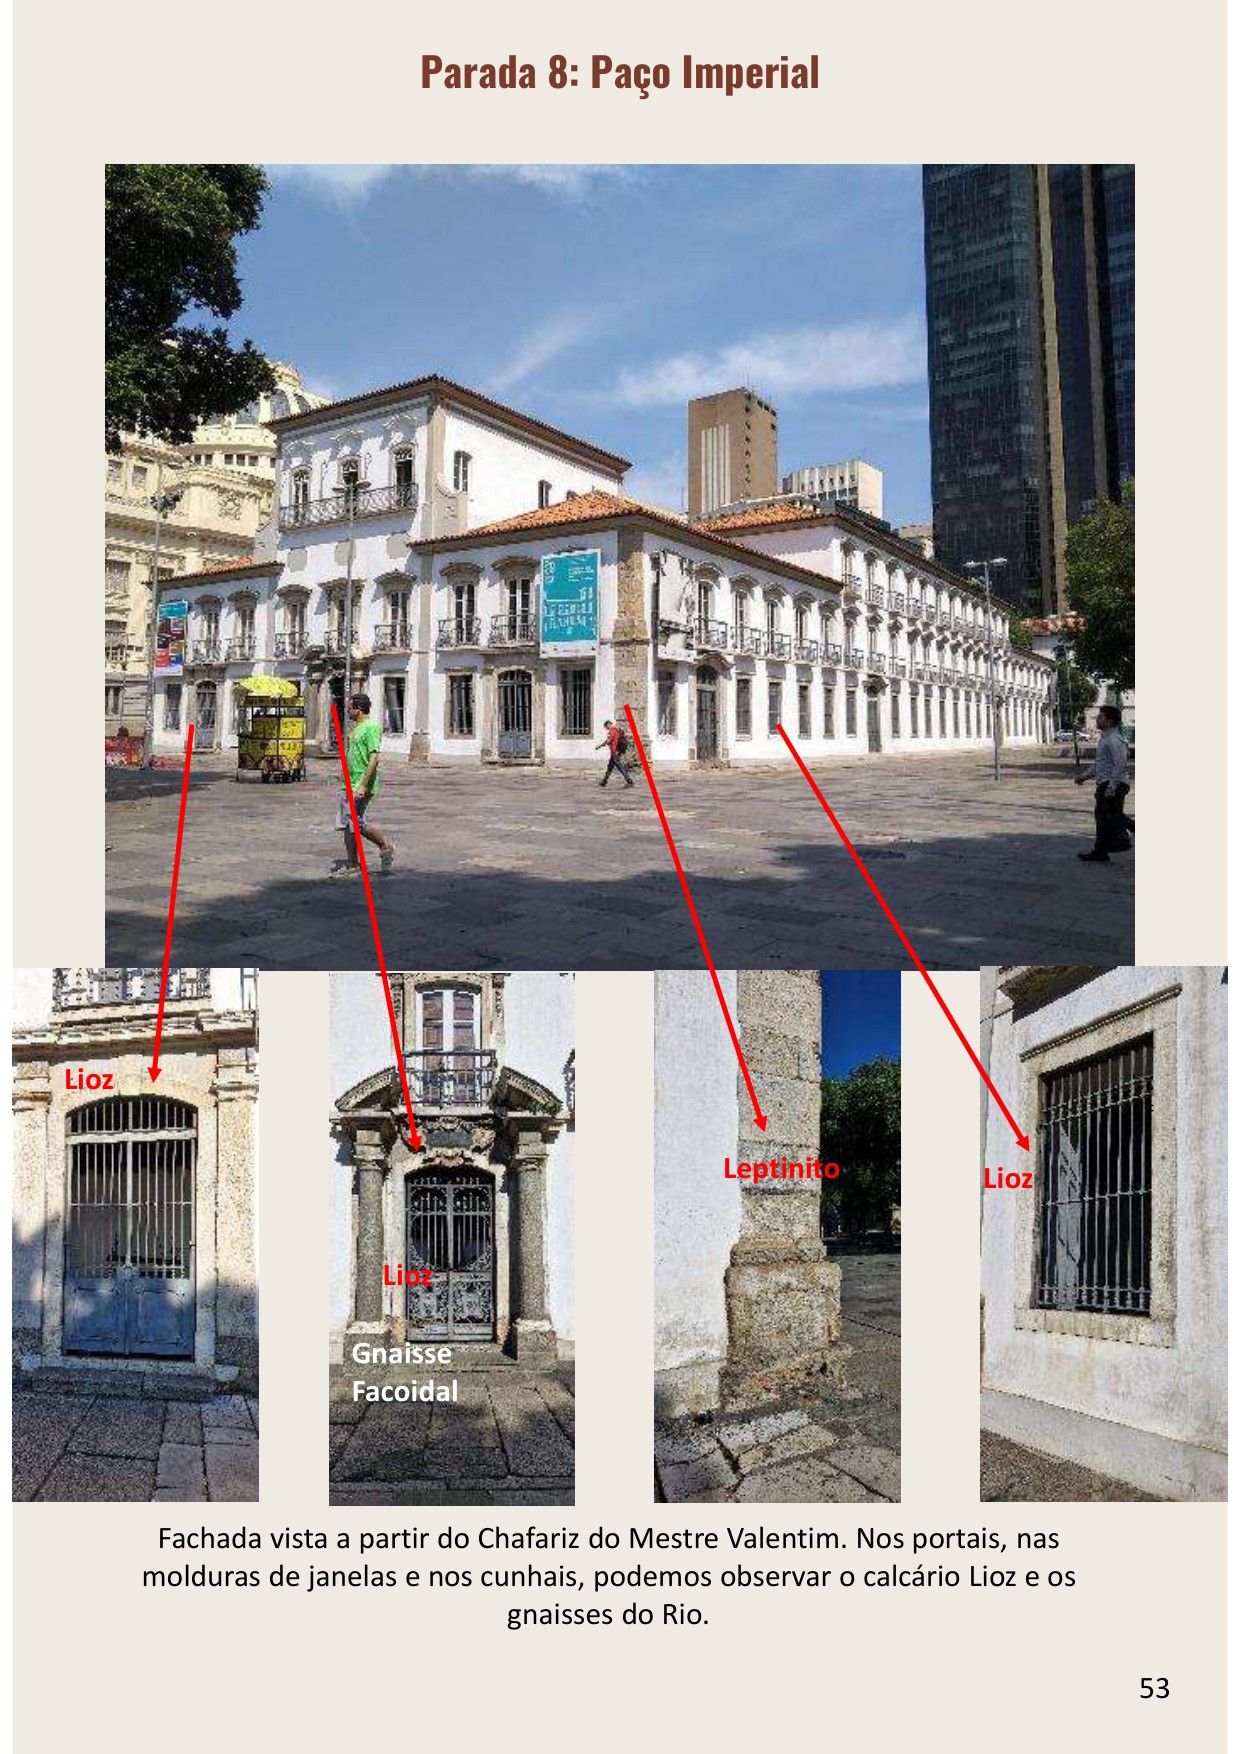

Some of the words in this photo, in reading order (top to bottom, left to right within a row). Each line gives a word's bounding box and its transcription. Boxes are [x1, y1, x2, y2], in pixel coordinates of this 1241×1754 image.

[421, 54, 536, 90] Parada
[548, 54, 579, 90] 8:
[591, 54, 671, 100] Paço
[683, 54, 819, 97] Imperial
[159, 1526, 262, 1550] Fachada
[269, 1526, 328, 1550] vista
[336, 1532, 350, 1550] a
[360, 1526, 430, 1555] partir
[437, 1525, 470, 1550] do
[478, 1525, 580, 1550] Chafariz
[588, 1525, 621, 1550] do
[629, 1527, 719, 1550] Mestre
[726, 1525, 847, 1550] Valentim.
[857, 1527, 905, 1550] Nos
[913, 1526, 1007, 1555] portais,
[1017, 1532, 1060, 1550] nas
[143, 1563, 261, 1588] molduras
[269, 1563, 300, 1588] de
[306, 1563, 397, 1593] janelas
[405, 1570, 420, 1588] e
[429, 1570, 473, 1588] nos
[480, 1563, 584, 1592] cunhais,
[594, 1563, 712, 1593] podemos
[720, 1563, 832, 1588] observar
[839, 1570, 855, 1588] o
[863, 1563, 961, 1588] calcário
[970, 1564, 1017, 1588] Lioz
[1025, 1570, 1040, 1588] e
[1047, 1570, 1076, 1588] os
[507, 1602, 613, 1631] gnaisses
[622, 1601, 654, 1626] do
[663, 1602, 709, 1626] Rio.
[1139, 1677, 1170, 1700] 53
